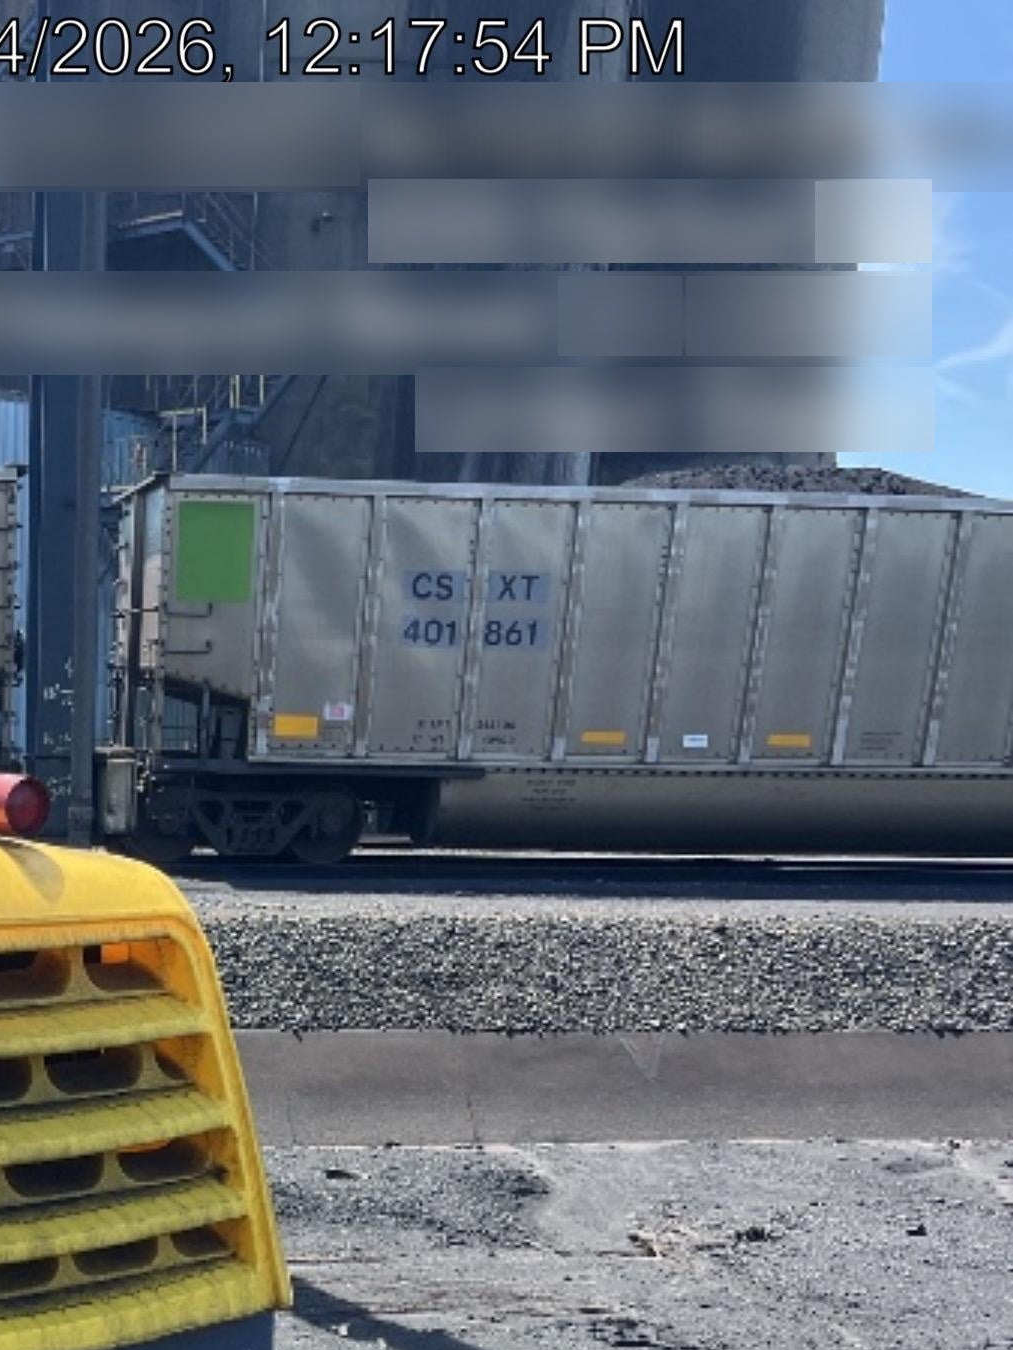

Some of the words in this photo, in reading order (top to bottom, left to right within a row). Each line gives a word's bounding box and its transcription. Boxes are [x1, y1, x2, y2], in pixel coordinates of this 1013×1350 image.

[412, 572, 453, 600] CS
[497, 574, 540, 600] XT
[404, 619, 456, 646] 401
[485, 619, 537, 646] 861
